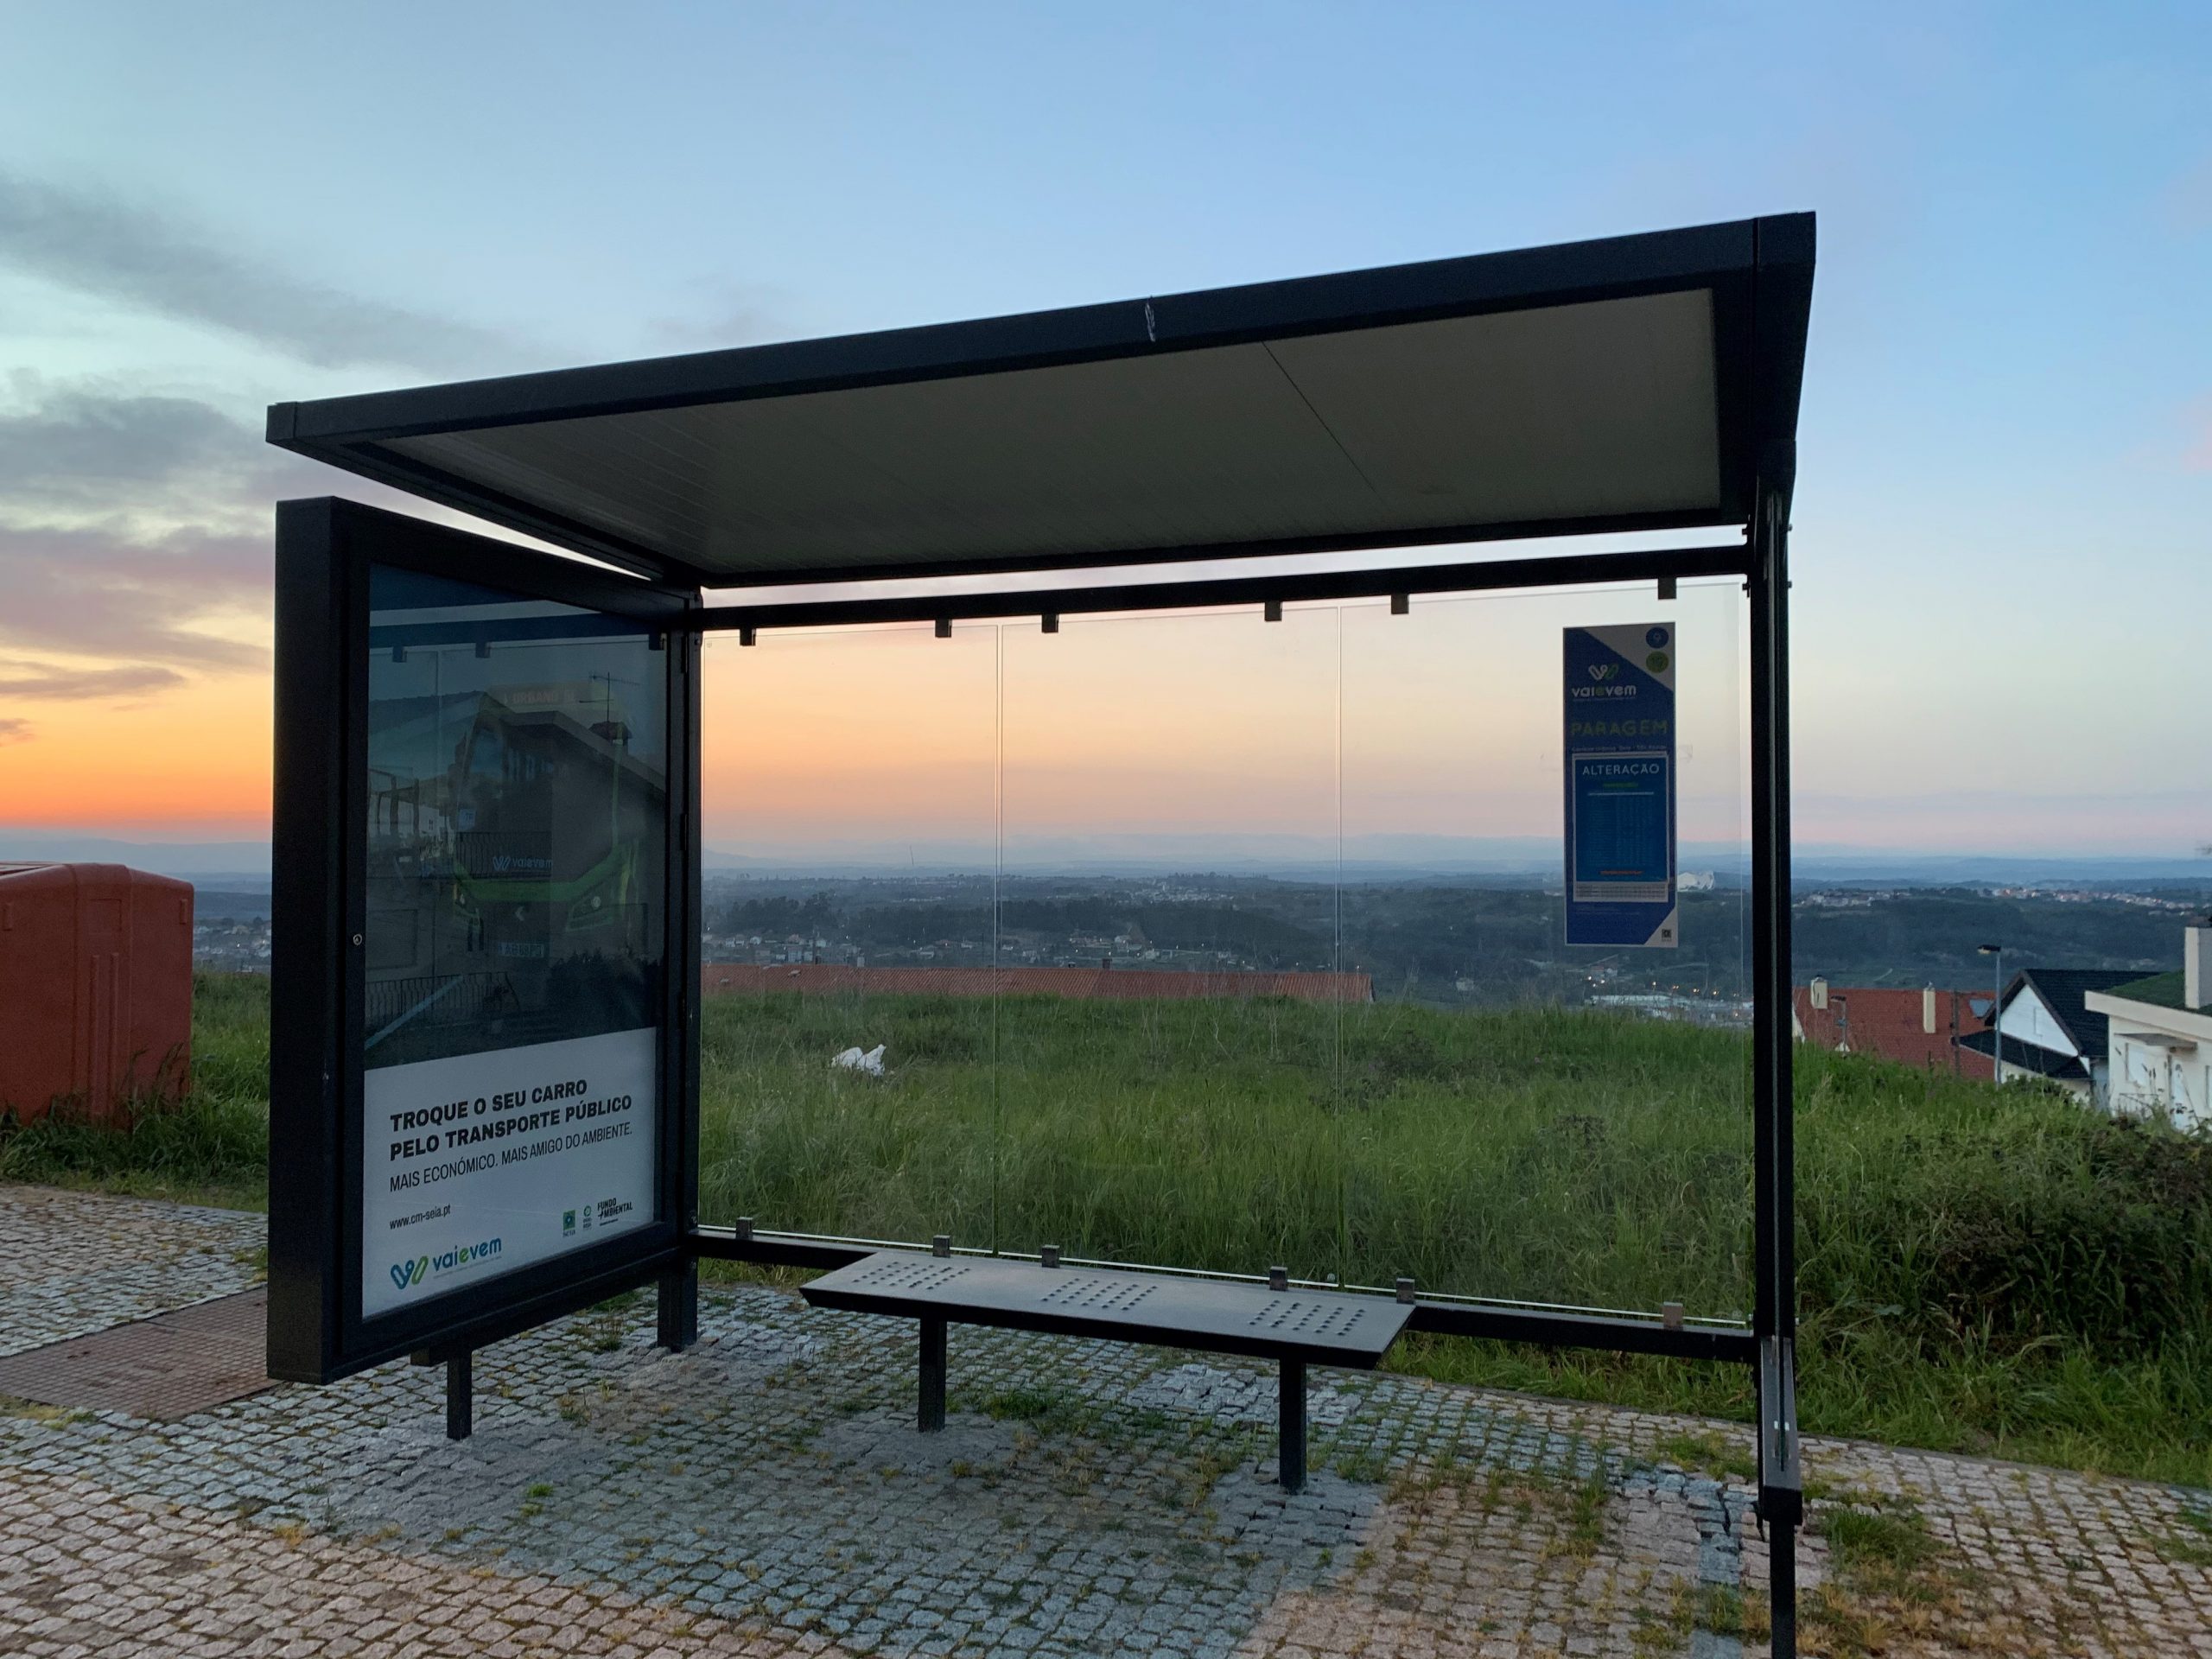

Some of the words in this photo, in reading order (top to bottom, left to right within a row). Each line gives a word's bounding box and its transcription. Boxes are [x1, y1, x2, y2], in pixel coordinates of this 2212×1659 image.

[1572, 685, 1637, 697] vaievem
[1571, 720, 1669, 736] PARAGEM
[1582, 763, 1660, 776] ALTERAÇÃO
[390, 1101, 468, 1132] TROQUE
[474, 1097, 486, 1116] O
[492, 1090, 526, 1112] SEU
[531, 1079, 588, 1104] CARRO
[390, 1135, 440, 1161] PELO
[445, 1109, 561, 1148] TRANSPORTE
[565, 1095, 632, 1122] PÚBLICO
[390, 1171, 420, 1192] MAIS
[423, 1154, 499, 1184] ECONÓMICO.
[501, 1146, 528, 1166] MAIS
[530, 1137, 563, 1159] AMIGO
[565, 1134, 581, 1150] DO
[582, 1122, 632, 1145] AMBIENTE.
[390, 1203, 451, 1230] www.cm-seia.pt
[597, 1198, 617, 1211] FUNDO
[433, 1237, 501, 1272] vaievem
